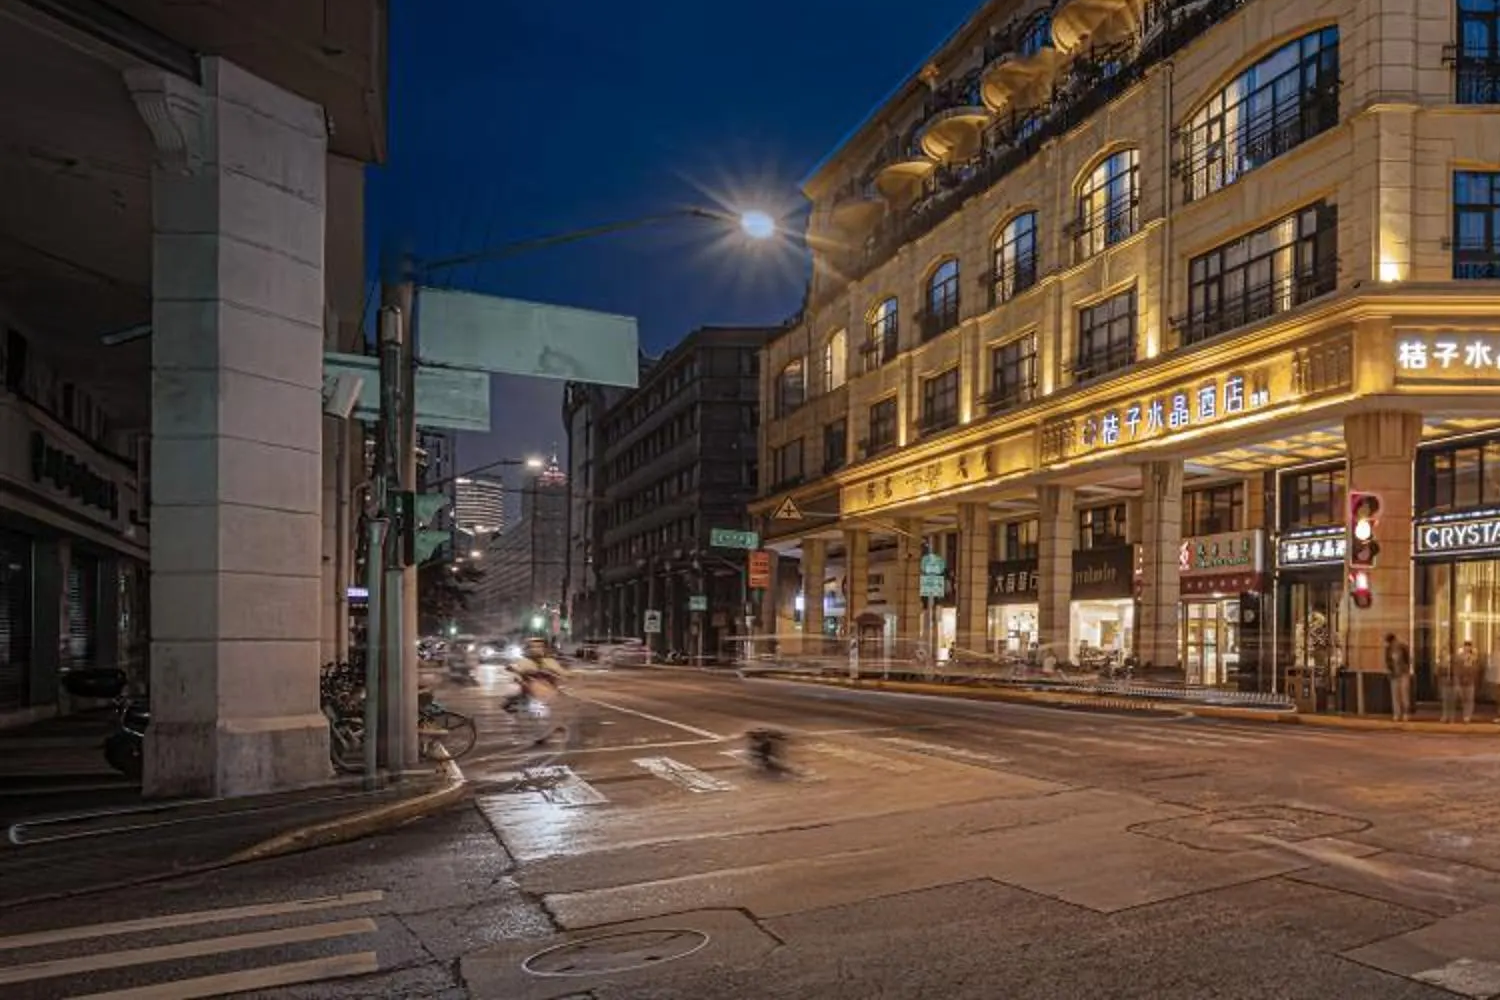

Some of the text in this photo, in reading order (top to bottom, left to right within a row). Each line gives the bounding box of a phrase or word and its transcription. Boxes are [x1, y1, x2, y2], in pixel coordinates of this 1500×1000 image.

[1103, 376, 1244, 445] 桔子水晶酒店
